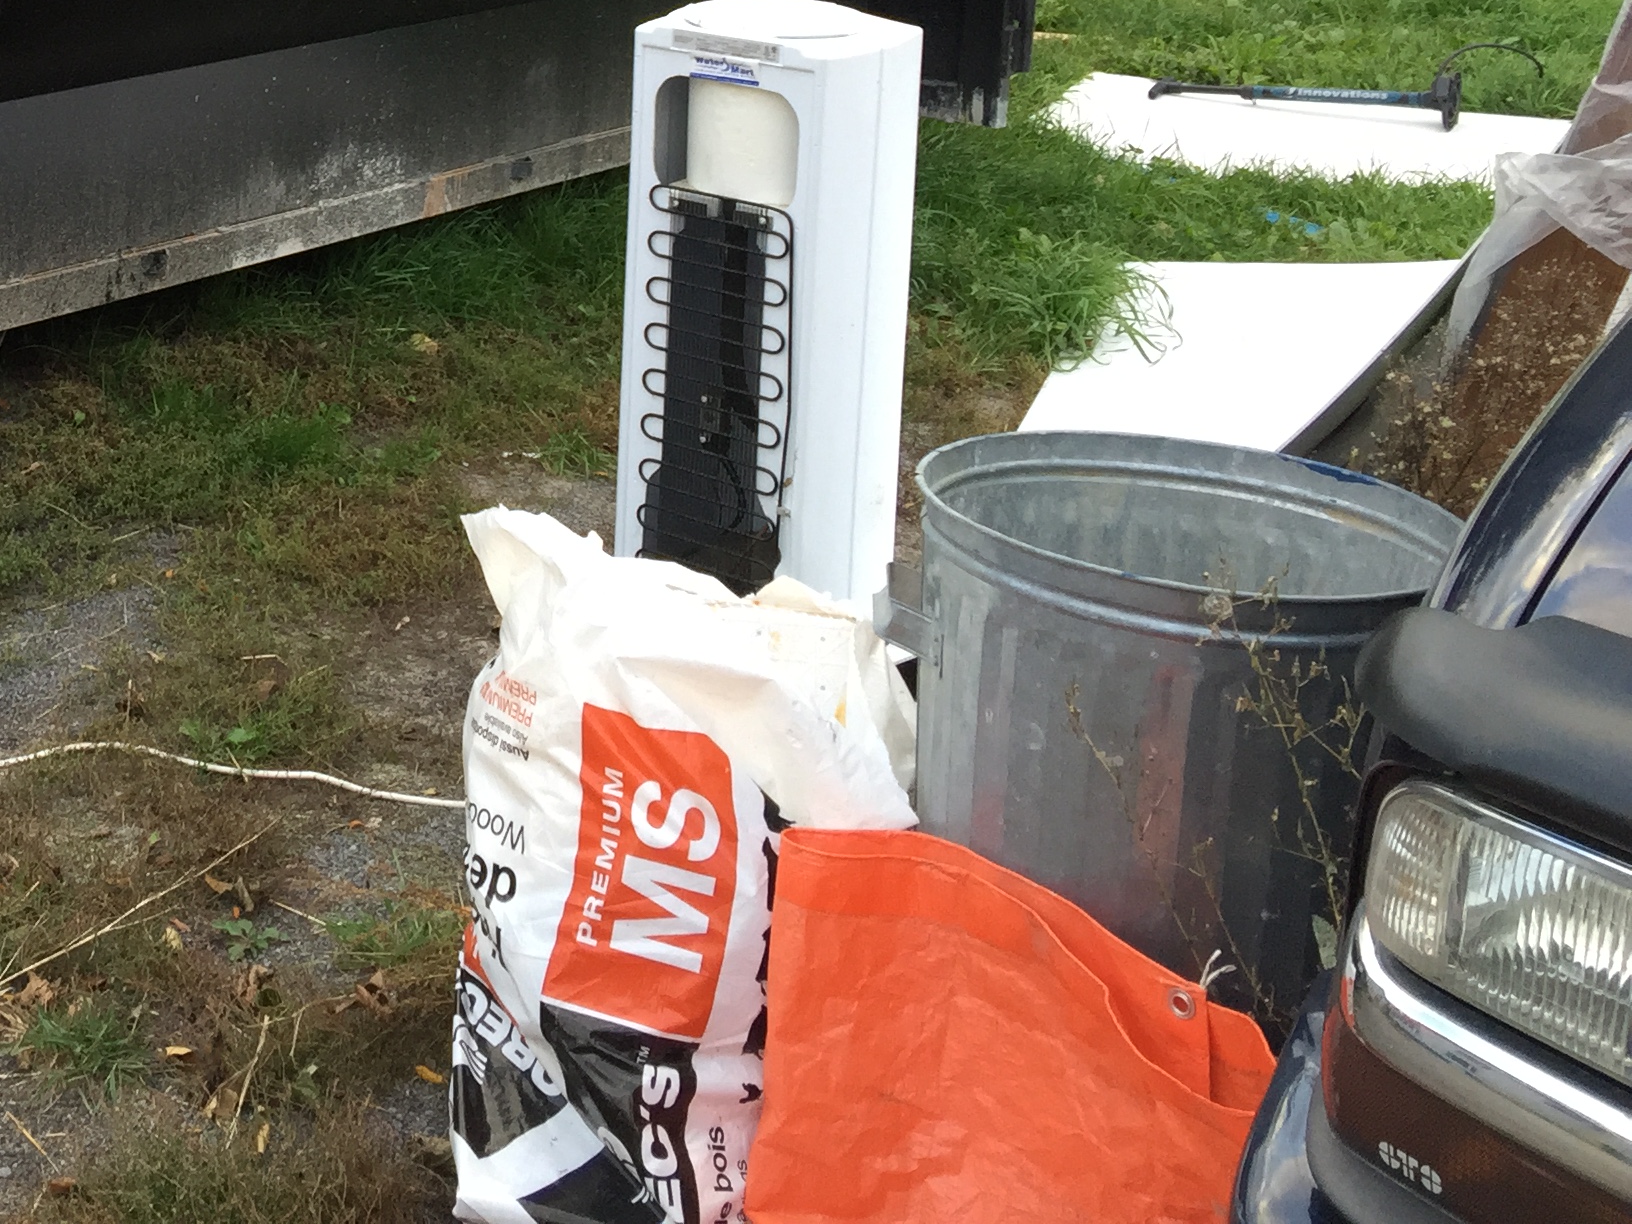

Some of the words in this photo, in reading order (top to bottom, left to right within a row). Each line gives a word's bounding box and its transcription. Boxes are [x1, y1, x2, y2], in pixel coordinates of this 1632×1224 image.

[1297, 88, 1388, 99] Innovations
[499, 739, 529, 761] Aussi
[576, 767, 624, 946] PREMIUM
[609, 780, 721, 974] MS
[708, 1126, 733, 1193] bois
